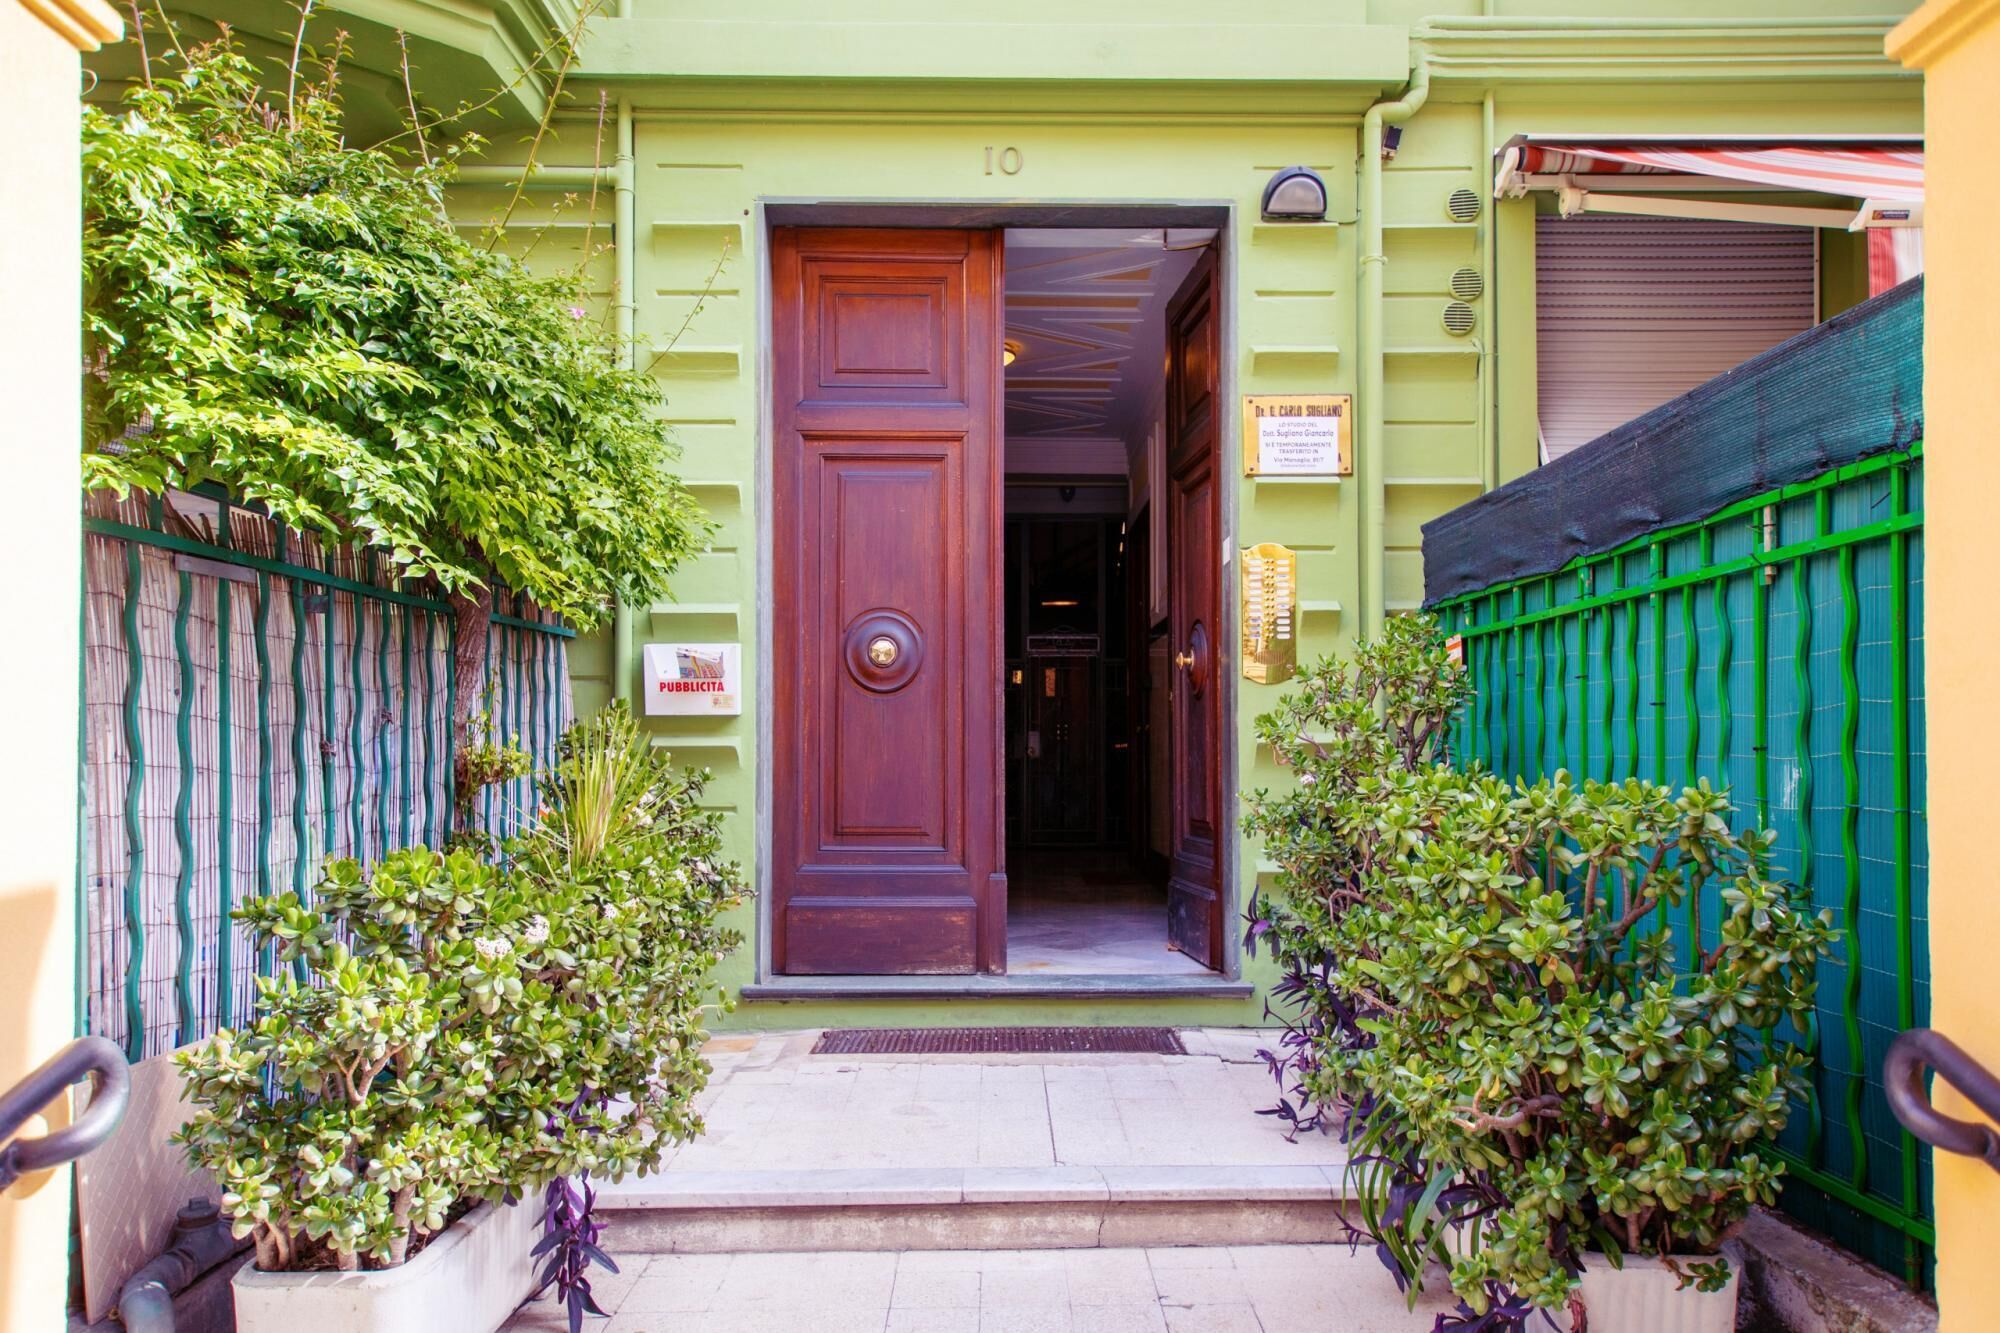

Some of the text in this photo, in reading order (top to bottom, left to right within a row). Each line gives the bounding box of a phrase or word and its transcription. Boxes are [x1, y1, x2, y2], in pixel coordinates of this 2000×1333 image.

[984, 146, 1024, 176] 10
[1279, 405, 1302, 417] CARLO
[1306, 404, 1343, 417] SUGLIANO
[1276, 429, 1303, 438] Sugliano
[1304, 429, 1334, 437] Giancarlo
